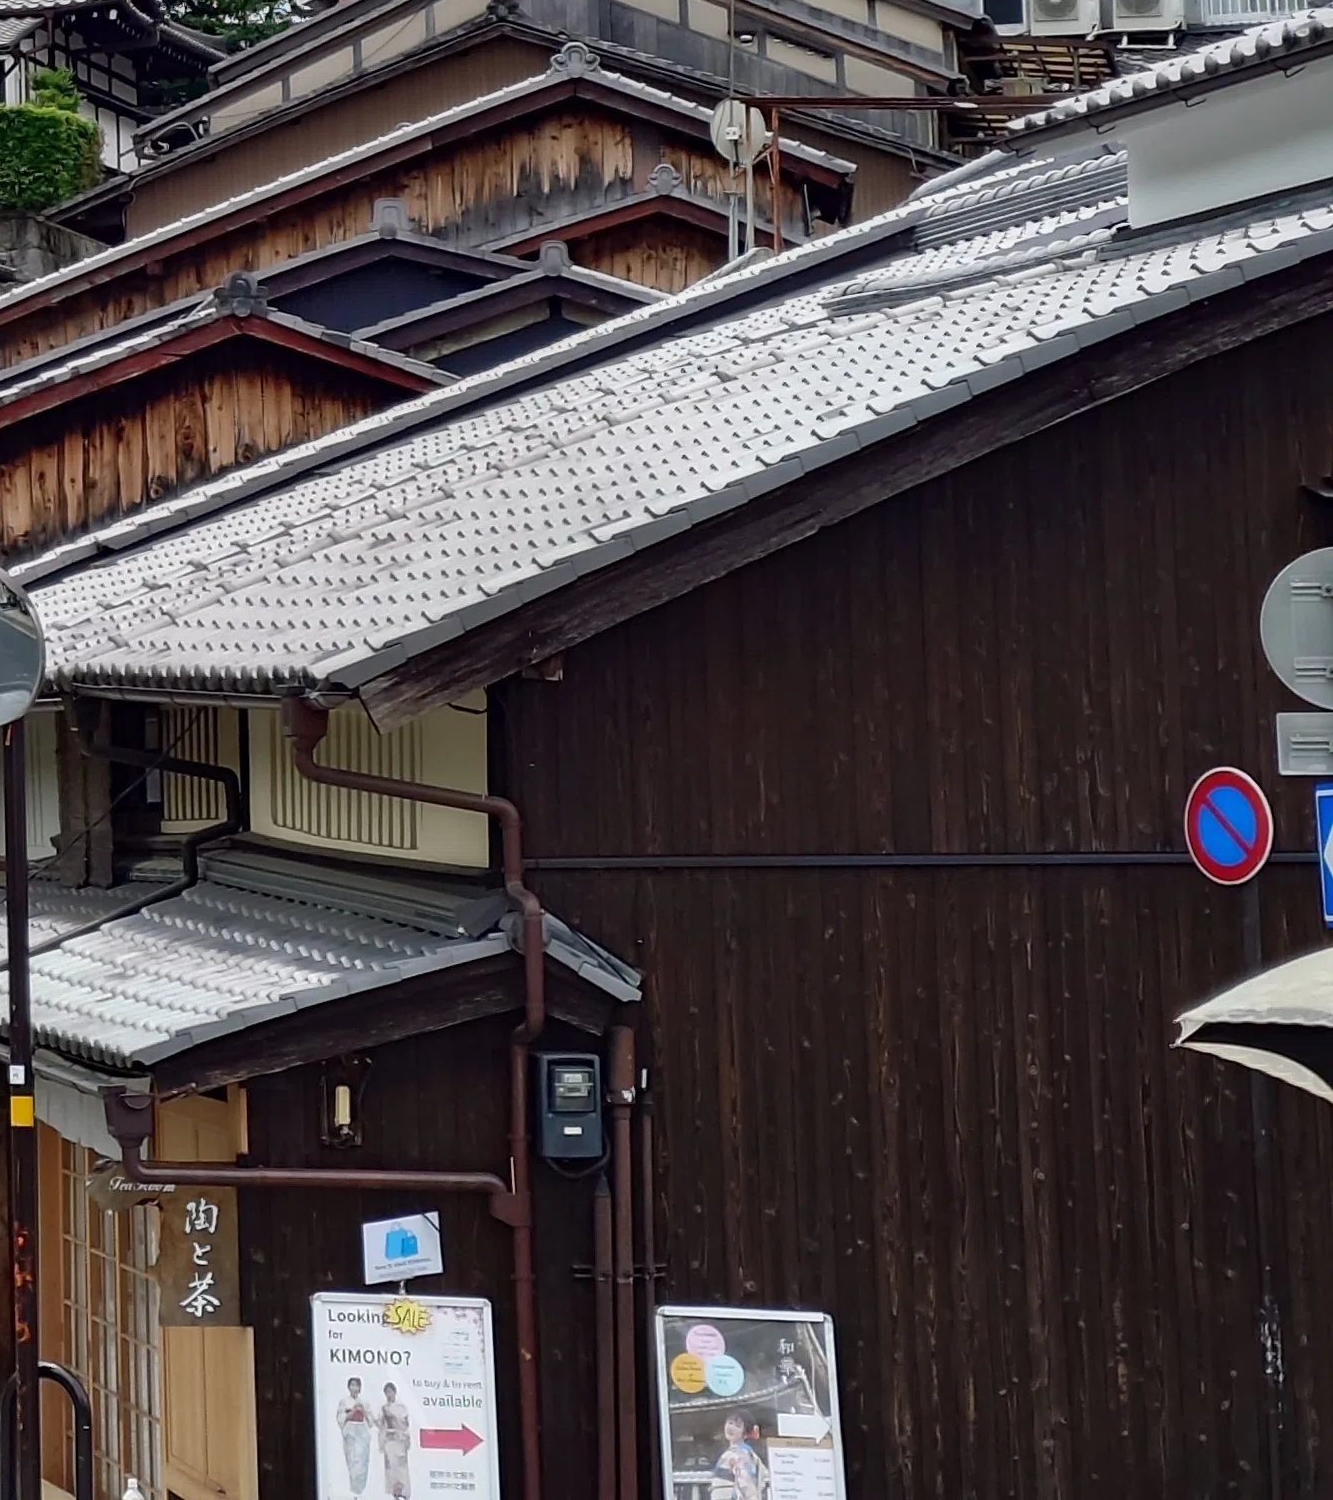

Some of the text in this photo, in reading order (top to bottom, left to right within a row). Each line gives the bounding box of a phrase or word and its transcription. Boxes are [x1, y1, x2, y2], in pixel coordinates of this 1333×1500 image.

[109, 1176, 134, 1192] Tea
[179, 1197, 221, 1317] 陶と茶
[393, 1305, 425, 1328] SALE
[328, 1329, 343, 1340] for
[330, 1348, 411, 1366] KIMONO?
[422, 1395, 483, 1408] available
